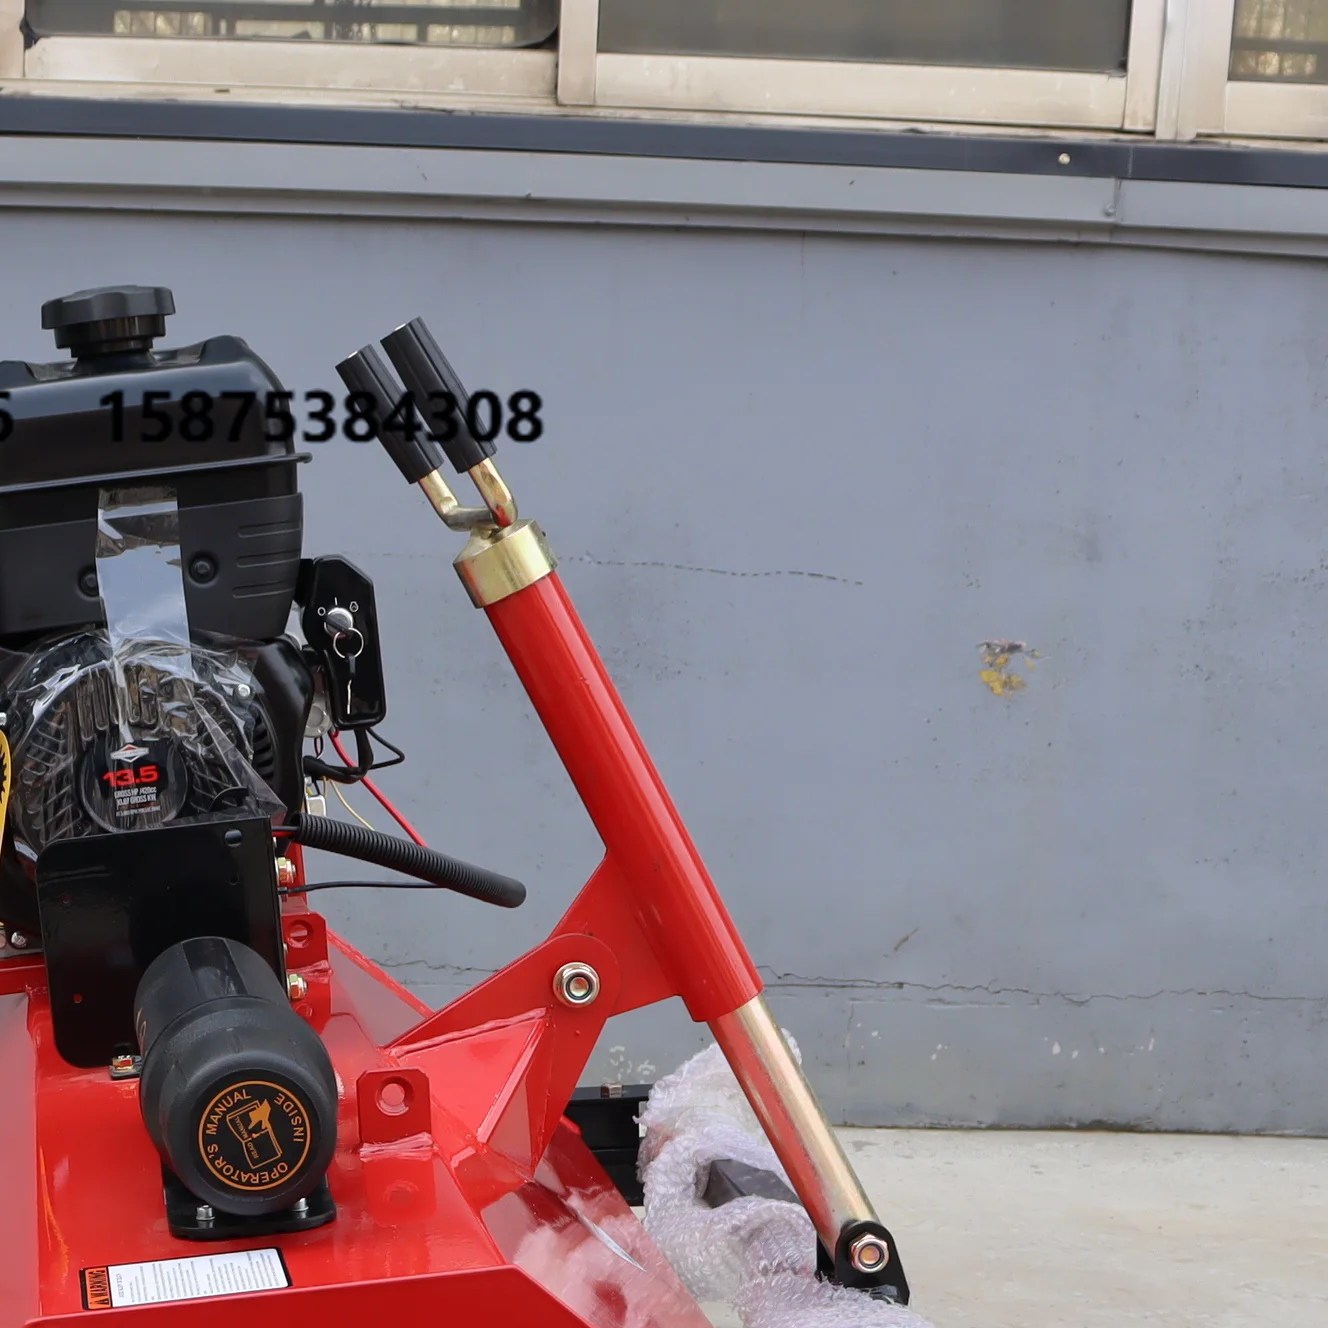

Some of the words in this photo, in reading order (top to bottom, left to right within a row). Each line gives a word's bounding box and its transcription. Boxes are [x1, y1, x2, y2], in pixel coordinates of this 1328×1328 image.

[102, 765, 159, 788] 13.5
[130, 795, 147, 804] GROSS
[205, 1088, 252, 1135] MANUAL
[274, 1092, 304, 1142] INSIDE
[207, 1143, 289, 1184] OPERATOR'S
[88, 1269, 108, 1298] WARNING
